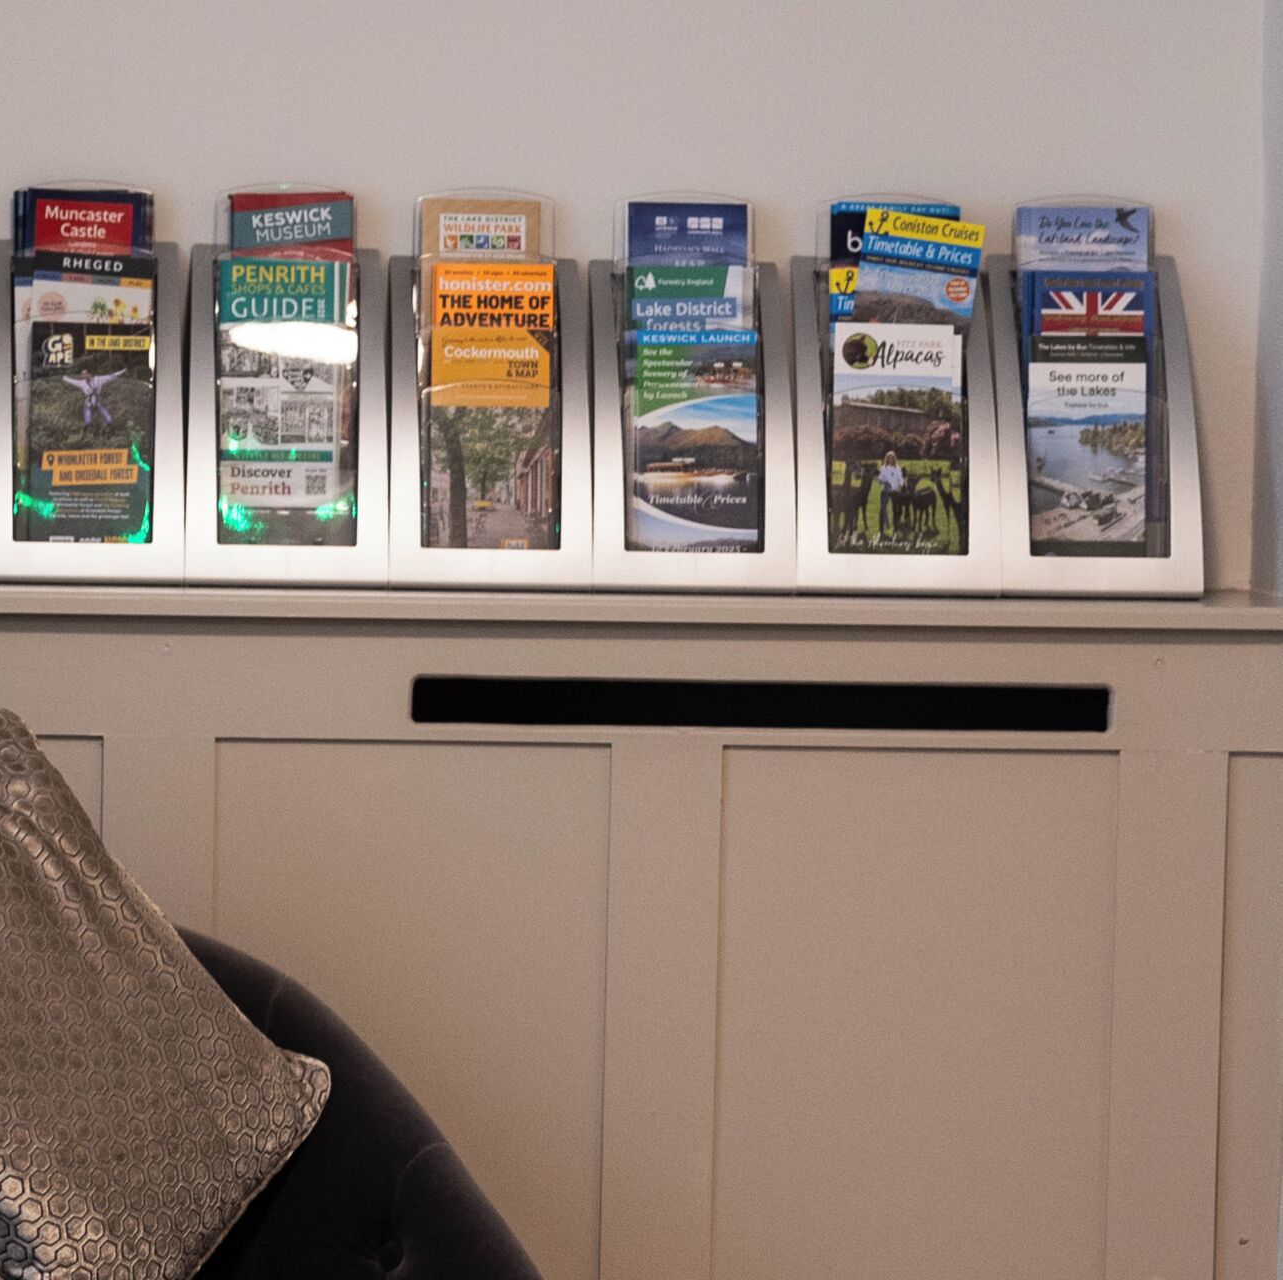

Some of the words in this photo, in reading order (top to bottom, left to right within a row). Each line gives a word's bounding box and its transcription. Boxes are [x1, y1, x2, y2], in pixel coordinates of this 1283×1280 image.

[44, 204, 125, 223] Muncaster
[251, 206, 333, 228] KESWICK
[461, 215, 482, 223] LAKE
[60, 222, 107, 239] Castle
[444, 223, 491, 233] WILDLIFE
[493, 224, 522, 234] PARK
[892, 216, 938, 235] Coniston
[941, 223, 980, 242] Cruises
[1038, 215, 1052, 229] Do
[1055, 215, 1072, 231] You
[256, 222, 332, 242] MUSEUM
[866, 235, 924, 258] Timetable
[925, 243, 936, 259] &
[938, 246, 974, 265] Prices
[62, 256, 124, 272] RHEGED
[232, 264, 326, 283] PENRITH
[231, 284, 272, 295] SHOPS
[438, 277, 552, 292] honister.com
[658, 279, 686, 287] Forestry
[687, 278, 715, 287] England
[231, 297, 315, 319] GUIDE
[439, 294, 473, 309] THE
[477, 295, 524, 310] HOME
[528, 296, 551, 310] OF
[637, 301, 672, 317] Lake
[675, 300, 732, 317] District
[440, 312, 550, 328] ADVENTURE
[642, 334, 697, 343] KESWICK
[701, 334, 750, 343] LAUNCH
[47, 351, 74, 367] APE
[443, 345, 540, 359] Cockermouth
[642, 348, 657, 356] See
[659, 347, 673, 356] the
[875, 340, 945, 369] Alpacas
[507, 361, 539, 369] TOWN
[643, 358, 693, 369] Spectacular
[515, 370, 538, 378] MAP
[642, 370, 676, 380] Scenery
[1049, 370, 1072, 383] See
[1076, 373, 1108, 382] more
[1111, 371, 1125, 382] of
[643, 391, 655, 401] by
[656, 390, 688, 399] Launch
[1057, 385, 1077, 397] the
[1081, 386, 1117, 397] Lakes
[229, 463, 293, 479] Discover
[229, 481, 292, 496] Penrith
[649, 493, 703, 506] Timetable
[713, 494, 747, 505] Prices
